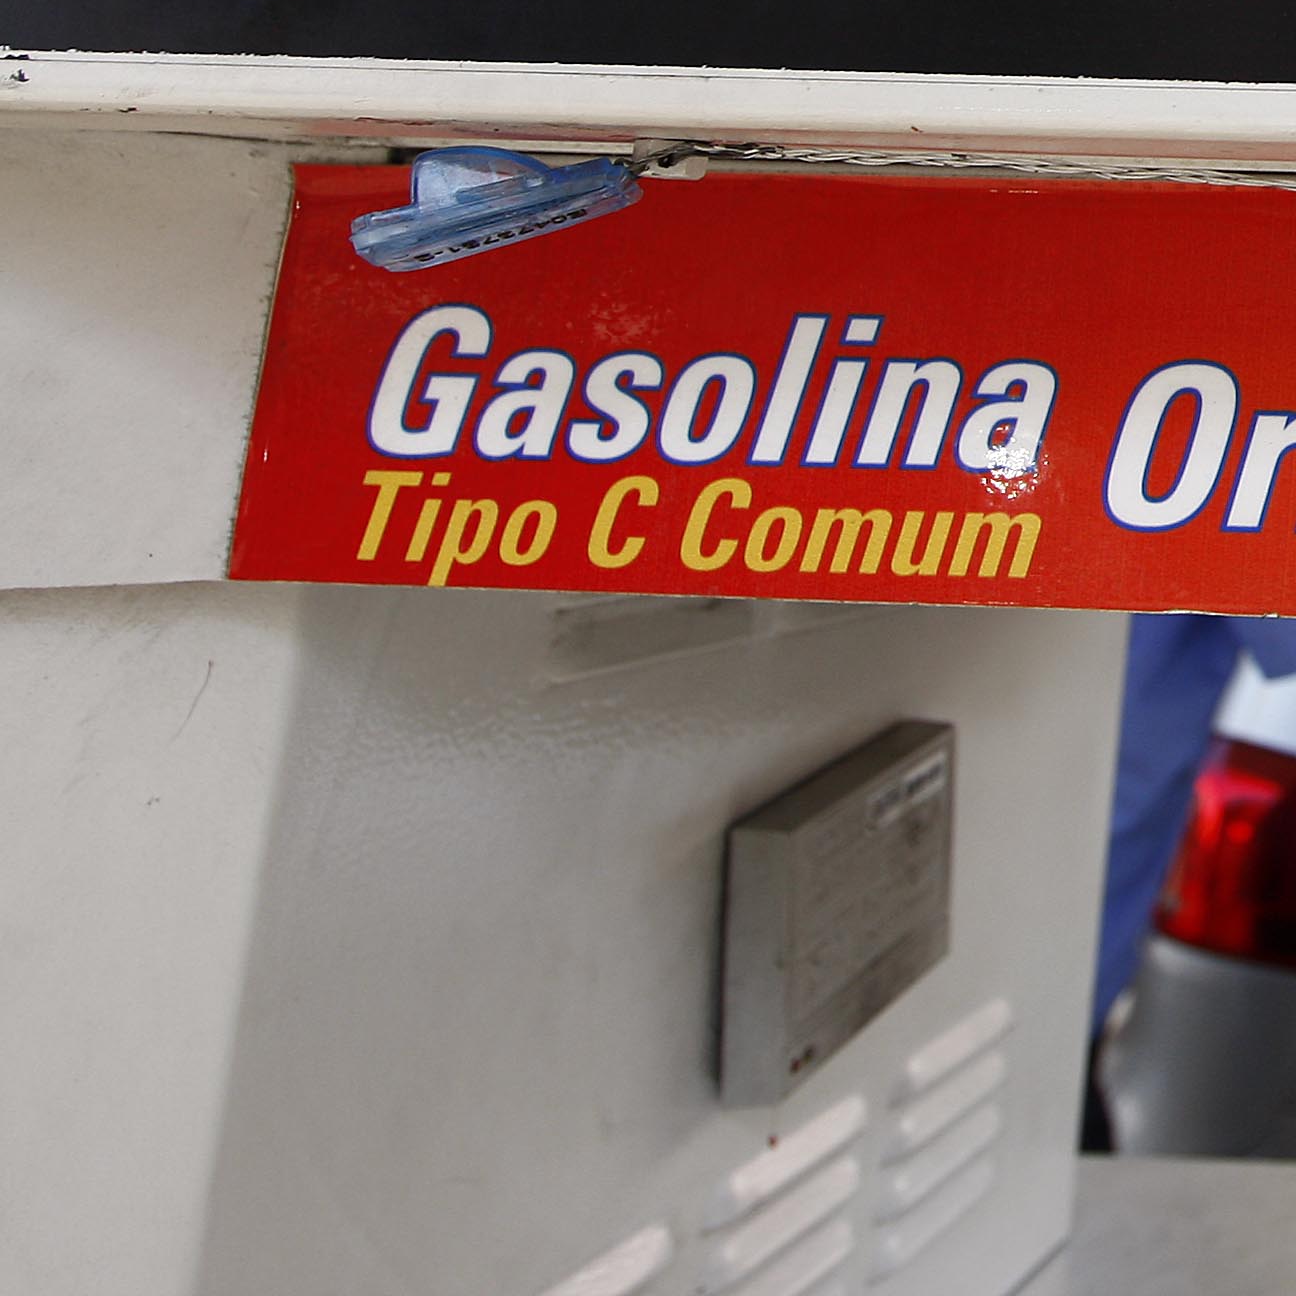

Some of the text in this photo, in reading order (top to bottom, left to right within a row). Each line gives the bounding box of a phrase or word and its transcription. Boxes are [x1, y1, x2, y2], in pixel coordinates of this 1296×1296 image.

[365, 303, 1061, 472] Gasolina
[355, 470, 1043, 587] Tipo C Comum
